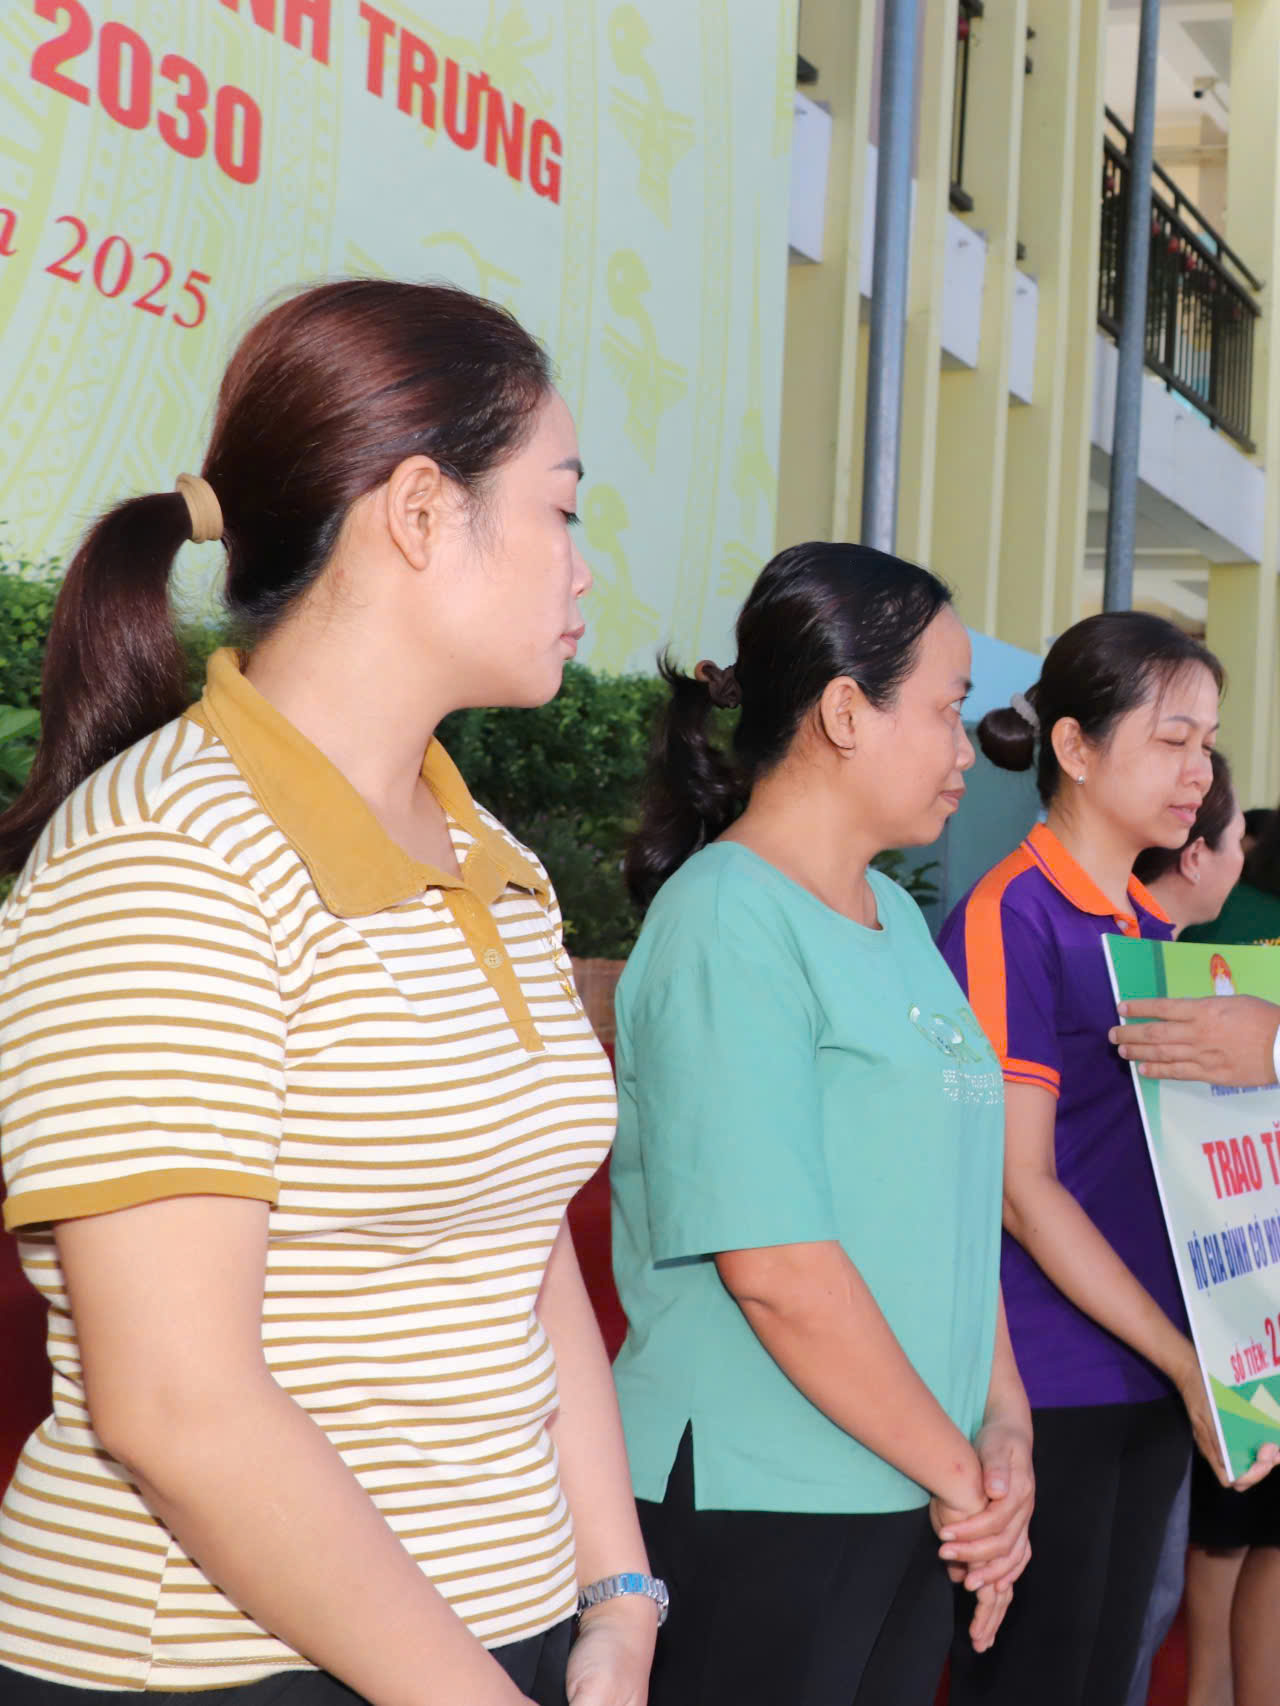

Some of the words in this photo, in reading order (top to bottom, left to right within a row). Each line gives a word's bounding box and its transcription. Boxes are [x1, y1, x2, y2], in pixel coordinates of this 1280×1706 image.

[29, 0, 262, 185] 2030
[358, 0, 563, 206] TRƯNG
[45, 215, 212, 328] 2025
[1202, 1135, 1263, 1199] TRAO
[1203, 1233, 1228, 1285] GIA
